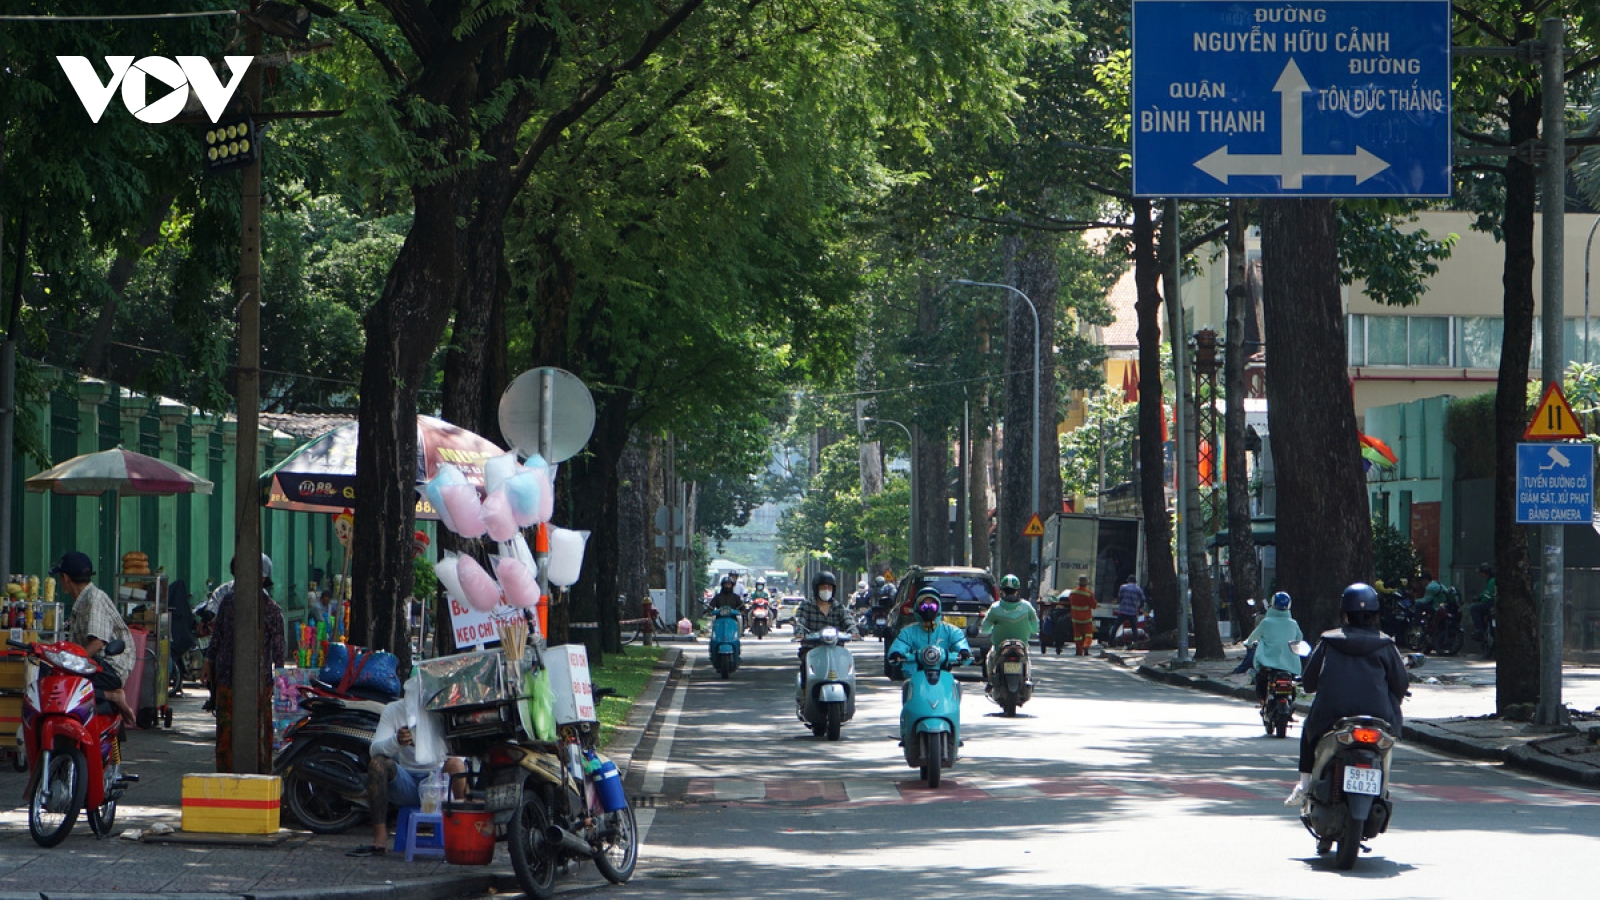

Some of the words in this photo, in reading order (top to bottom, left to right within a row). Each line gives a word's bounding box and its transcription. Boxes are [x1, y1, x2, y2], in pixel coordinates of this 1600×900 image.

[1254, 6, 1327, 23] ĐƯỜNG
[1193, 25, 1277, 52] NGUYỄN
[1284, 29, 1328, 52] HỮU
[1335, 26, 1390, 52] CẢNH
[1348, 54, 1421, 75] ĐƯỜNG
[1169, 80, 1226, 101] QUẬN
[1319, 84, 1350, 111] TÔN
[1353, 82, 1386, 111] ĐỨC
[1388, 79, 1442, 111] THẮNG
[1141, 104, 1190, 133] BÌNH
[1197, 110, 1265, 136] THẠNH
[1523, 474, 1547, 488] TUYẾN
[1549, 474, 1575, 488] ĐƯỜNG
[1576, 474, 1587, 488] CÓ
[1520, 490, 1539, 503] GIÁM
[1570, 493, 1590, 506] PHẠT
[1528, 504, 1549, 520] BẰNG
[1551, 509, 1581, 520] CAMERA
[456, 625, 477, 642] KẸO
[1349, 769, 1376, 782] 59-T2
